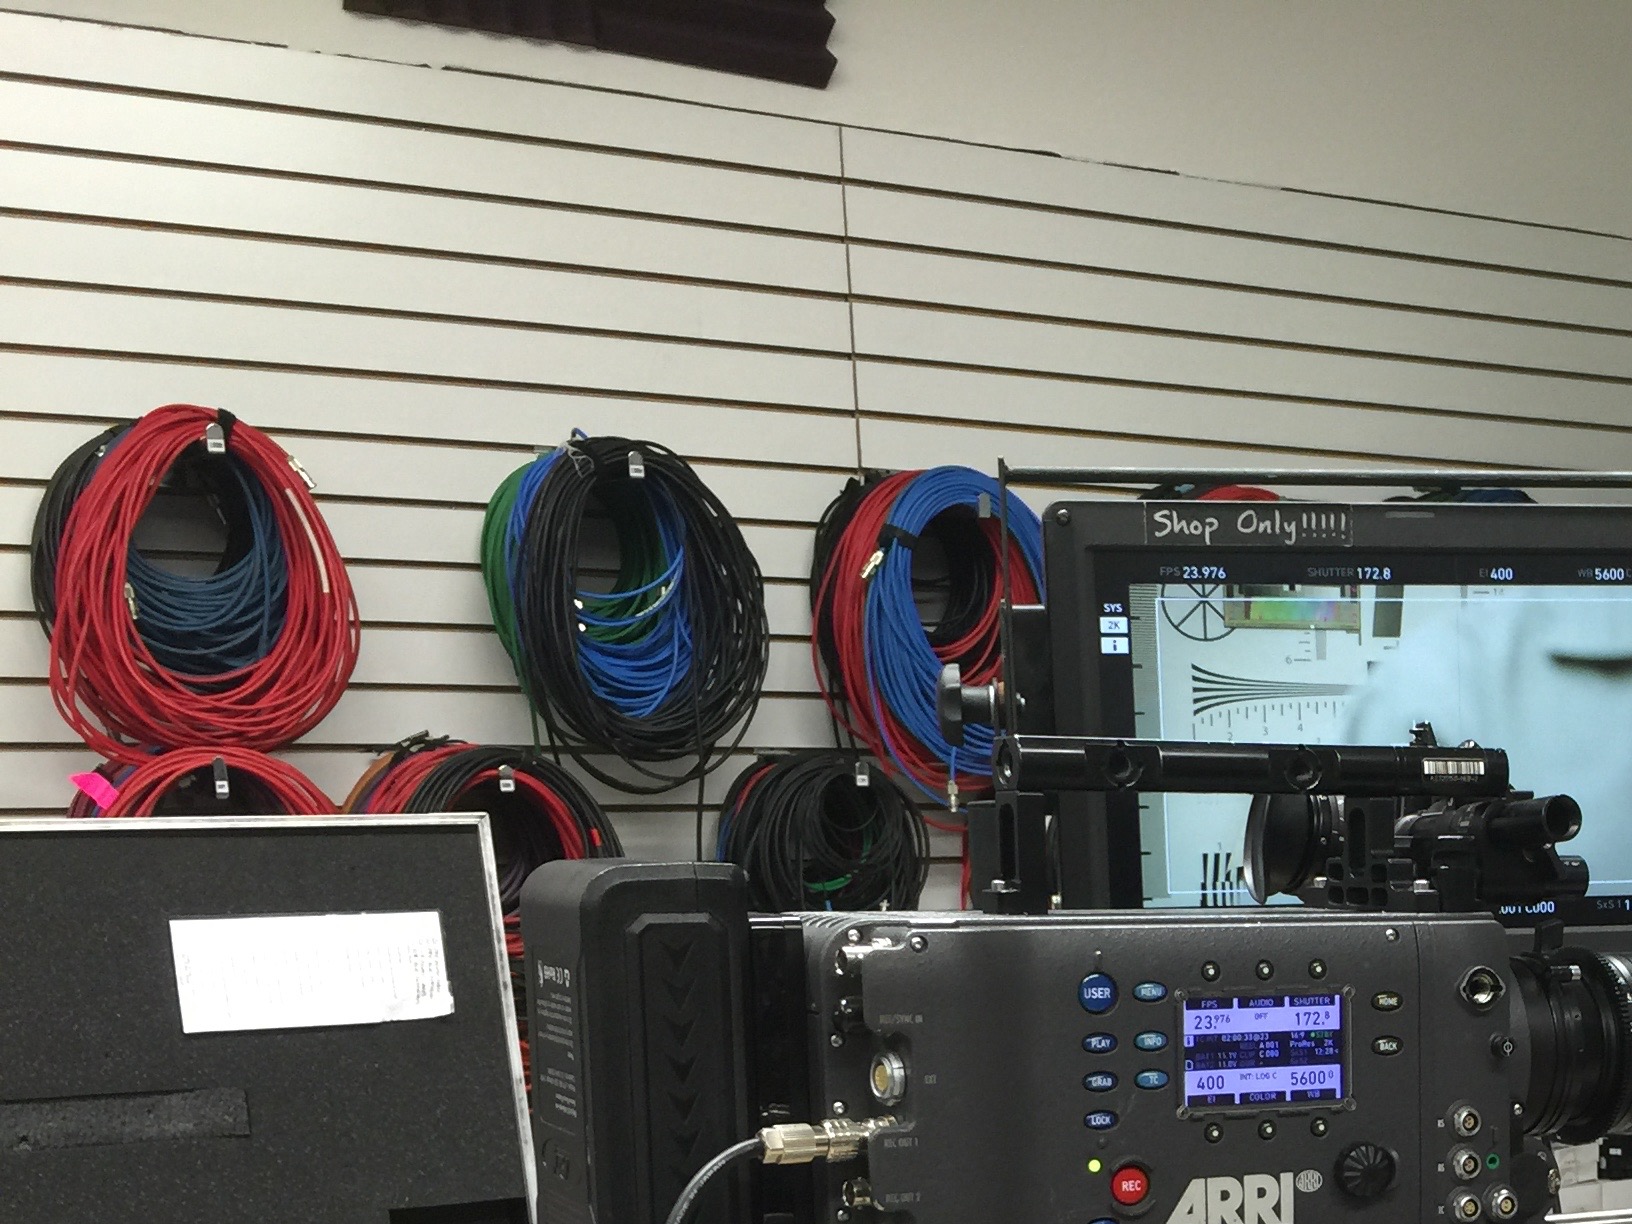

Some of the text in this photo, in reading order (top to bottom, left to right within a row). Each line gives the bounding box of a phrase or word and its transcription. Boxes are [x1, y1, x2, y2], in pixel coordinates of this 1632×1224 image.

[1153, 509, 1219, 545] Shop
[1159, 566, 1227, 580] FPS 23.976
[1307, 566, 1392, 581] SHUTTER 172.8
[1490, 567, 1514, 581] 400
[1594, 567, 1625, 581] 5600
[1103, 603, 1123, 613] SYS
[1108, 620, 1121, 630] 2K
[1083, 987, 1111, 999] USER
[1201, 1000, 1218, 1009] FPS
[1249, 998, 1274, 1007] AUDIO
[1294, 997, 1331, 1006] SHUTTER
[1194, 1014, 1231, 1030] 23.976
[1295, 1010, 1330, 1026] 172.8
[1091, 1039, 1111, 1048] PLAY
[1379, 1042, 1398, 1051] BACK
[1091, 1077, 1112, 1087] GRAB
[1149, 1075, 1159, 1085] TC
[1196, 1075, 1225, 1090] 400
[1290, 1071, 1326, 1086] 5600
[1249, 1093, 1277, 1101] COLOR
[1090, 1116, 1111, 1125] LOCK
[700, 1159, 726, 1186] JAPAN
[1121, 1180, 1142, 1192] REC
